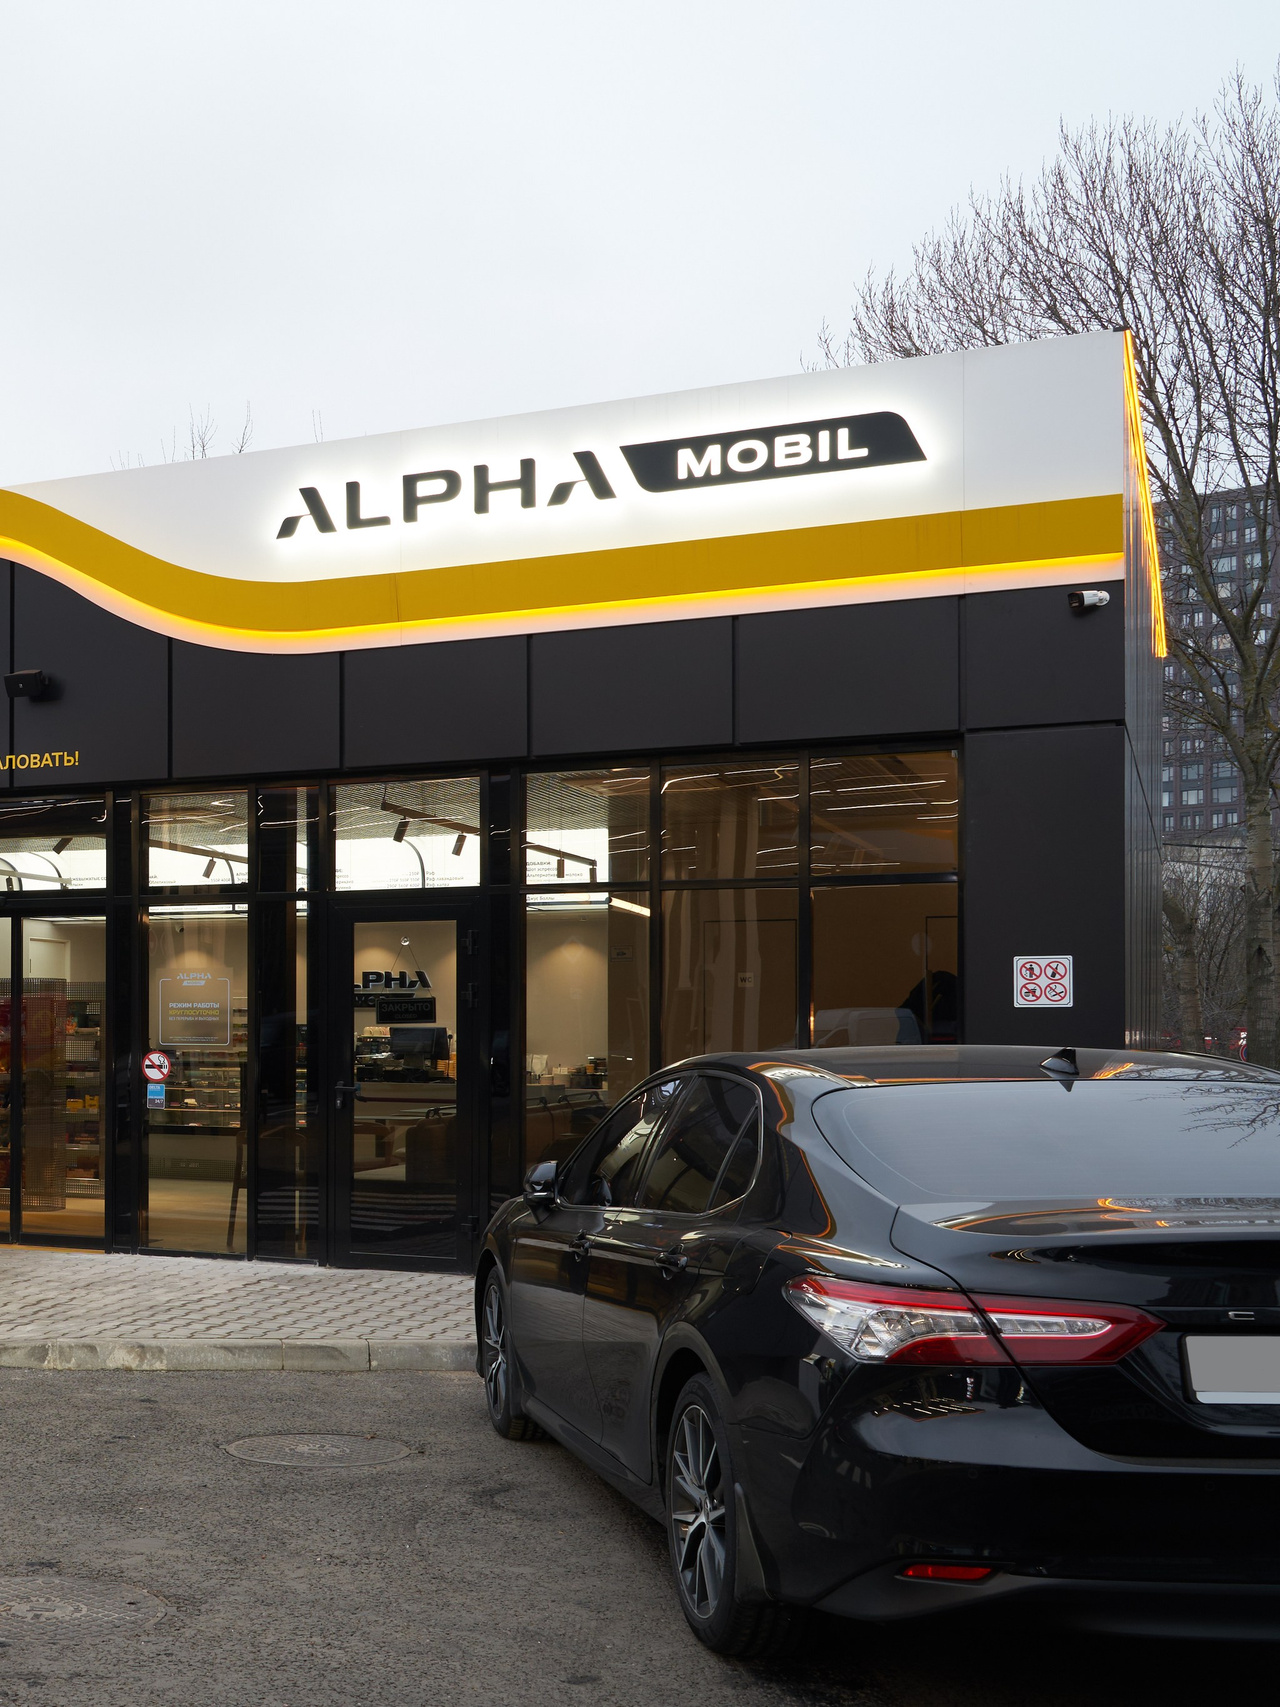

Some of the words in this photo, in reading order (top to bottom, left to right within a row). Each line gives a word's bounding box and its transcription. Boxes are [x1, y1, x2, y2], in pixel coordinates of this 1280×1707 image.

[276, 450, 617, 540] ALPHA
[677, 427, 869, 481] MOBIL
[176, 972, 212, 980] ALPHA
[381, 1003, 431, 1012] ЗАКРЫТО
